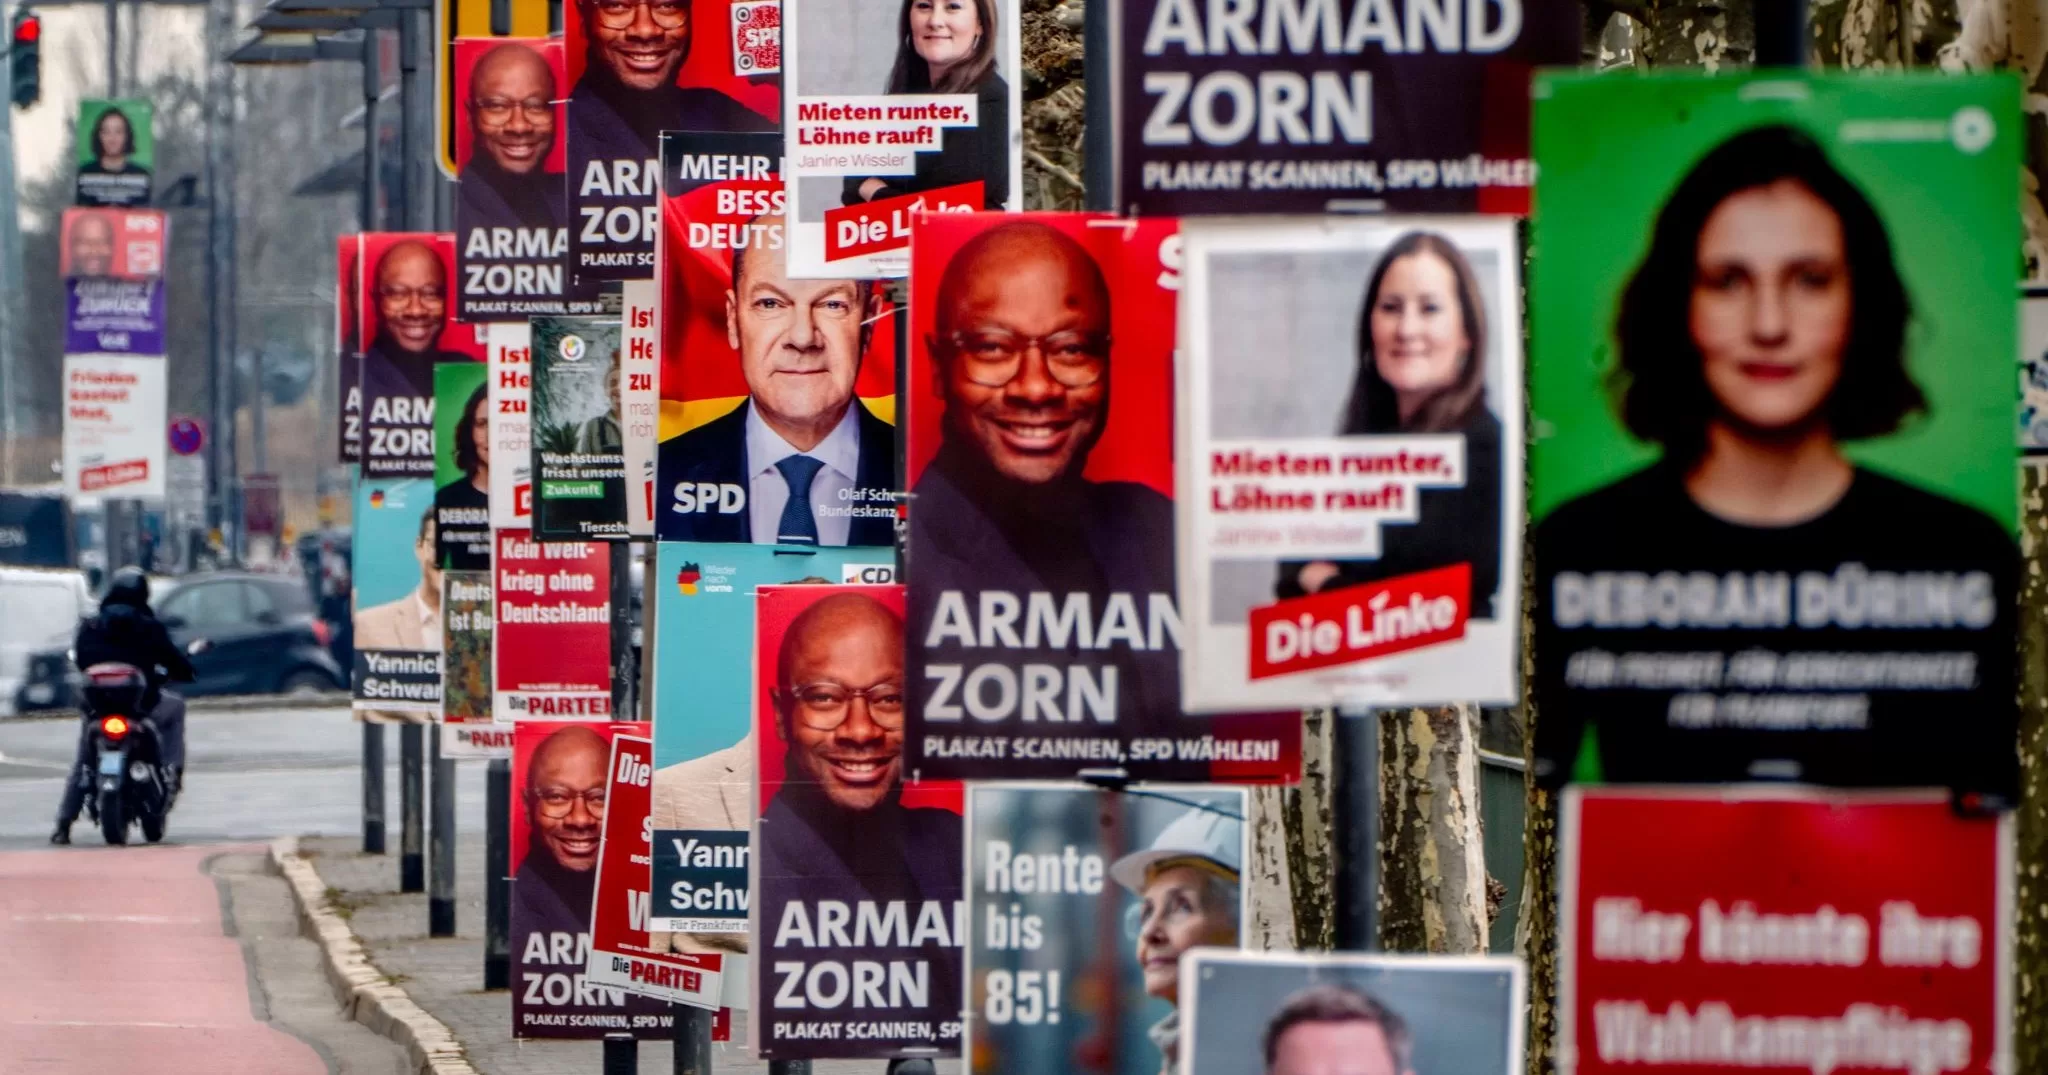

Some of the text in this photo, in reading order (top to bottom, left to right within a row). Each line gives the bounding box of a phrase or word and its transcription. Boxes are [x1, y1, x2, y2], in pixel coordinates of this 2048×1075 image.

[1142, 0, 1524, 55] ARMAND
[798, 102, 970, 122] Mieten runter,
[1142, 71, 1373, 146] ZORN
[798, 126, 933, 145] Löhne rauf!
[680, 155, 772, 181] MEHR
[797, 153, 907, 168] Janine Wissler
[1142, 161, 1244, 190] PLAKAT
[1248, 161, 1386, 192] SCANNEN,
[1387, 161, 1439, 190] SPD
[717, 189, 785, 216] BESS
[465, 227, 568, 259] ARMA
[689, 223, 783, 250] DEUTS
[837, 216, 888, 249] Die
[581, 253, 633, 266] PLAKAT
[465, 264, 563, 295] ZORN
[465, 302, 507, 313] PLAKAT
[629, 374, 651, 391] zu
[499, 400, 527, 413] zu
[369, 427, 436, 456] ZOR
[541, 467, 578, 479] frisst
[1210, 450, 1454, 480] Mieten runter,
[545, 484, 601, 496] Zukunft
[672, 482, 746, 513] SPD
[838, 488, 868, 501] Olaf
[1210, 484, 1405, 514] Löhne rauf!
[819, 504, 896, 518] Bundeskanz
[580, 521, 629, 533] Tiersch
[501, 537, 539, 560] Kein
[543, 542, 594, 560] Welt-
[501, 569, 594, 596] krieg ohne
[704, 585, 733, 593] vorne
[1552, 560, 1997, 629] DEBORAH DÜRING
[449, 610, 469, 631] ist
[501, 601, 611, 623] Deutschland
[925, 590, 1183, 651] ARMAN
[1265, 590, 1458, 664] Die Linke
[508, 696, 611, 716] Die PARTEI
[923, 662, 1118, 723] ZORN
[923, 735, 1280, 763] PLAKAT SCANNEN, SPD WÄHLEN!
[616, 752, 650, 788] Die
[985, 841, 1102, 895] Rente
[670, 919, 689, 930] Für
[690, 919, 740, 931] Frankfurt
[773, 900, 964, 947] ARMA
[985, 904, 1043, 950] bis
[1593, 896, 1692, 963] Hier
[1699, 897, 1871, 967] könnte
[611, 956, 702, 994] Die PARTEI
[773, 960, 929, 1009] ZORN
[985, 970, 1061, 1025] 85!
[523, 1013, 568, 1026] PLAKAT
[569, 1014, 631, 1029] SCANNEN,
[632, 1015, 657, 1027] SPD
[773, 1022, 964, 1041] PLAKAT SCANNEN, SP
